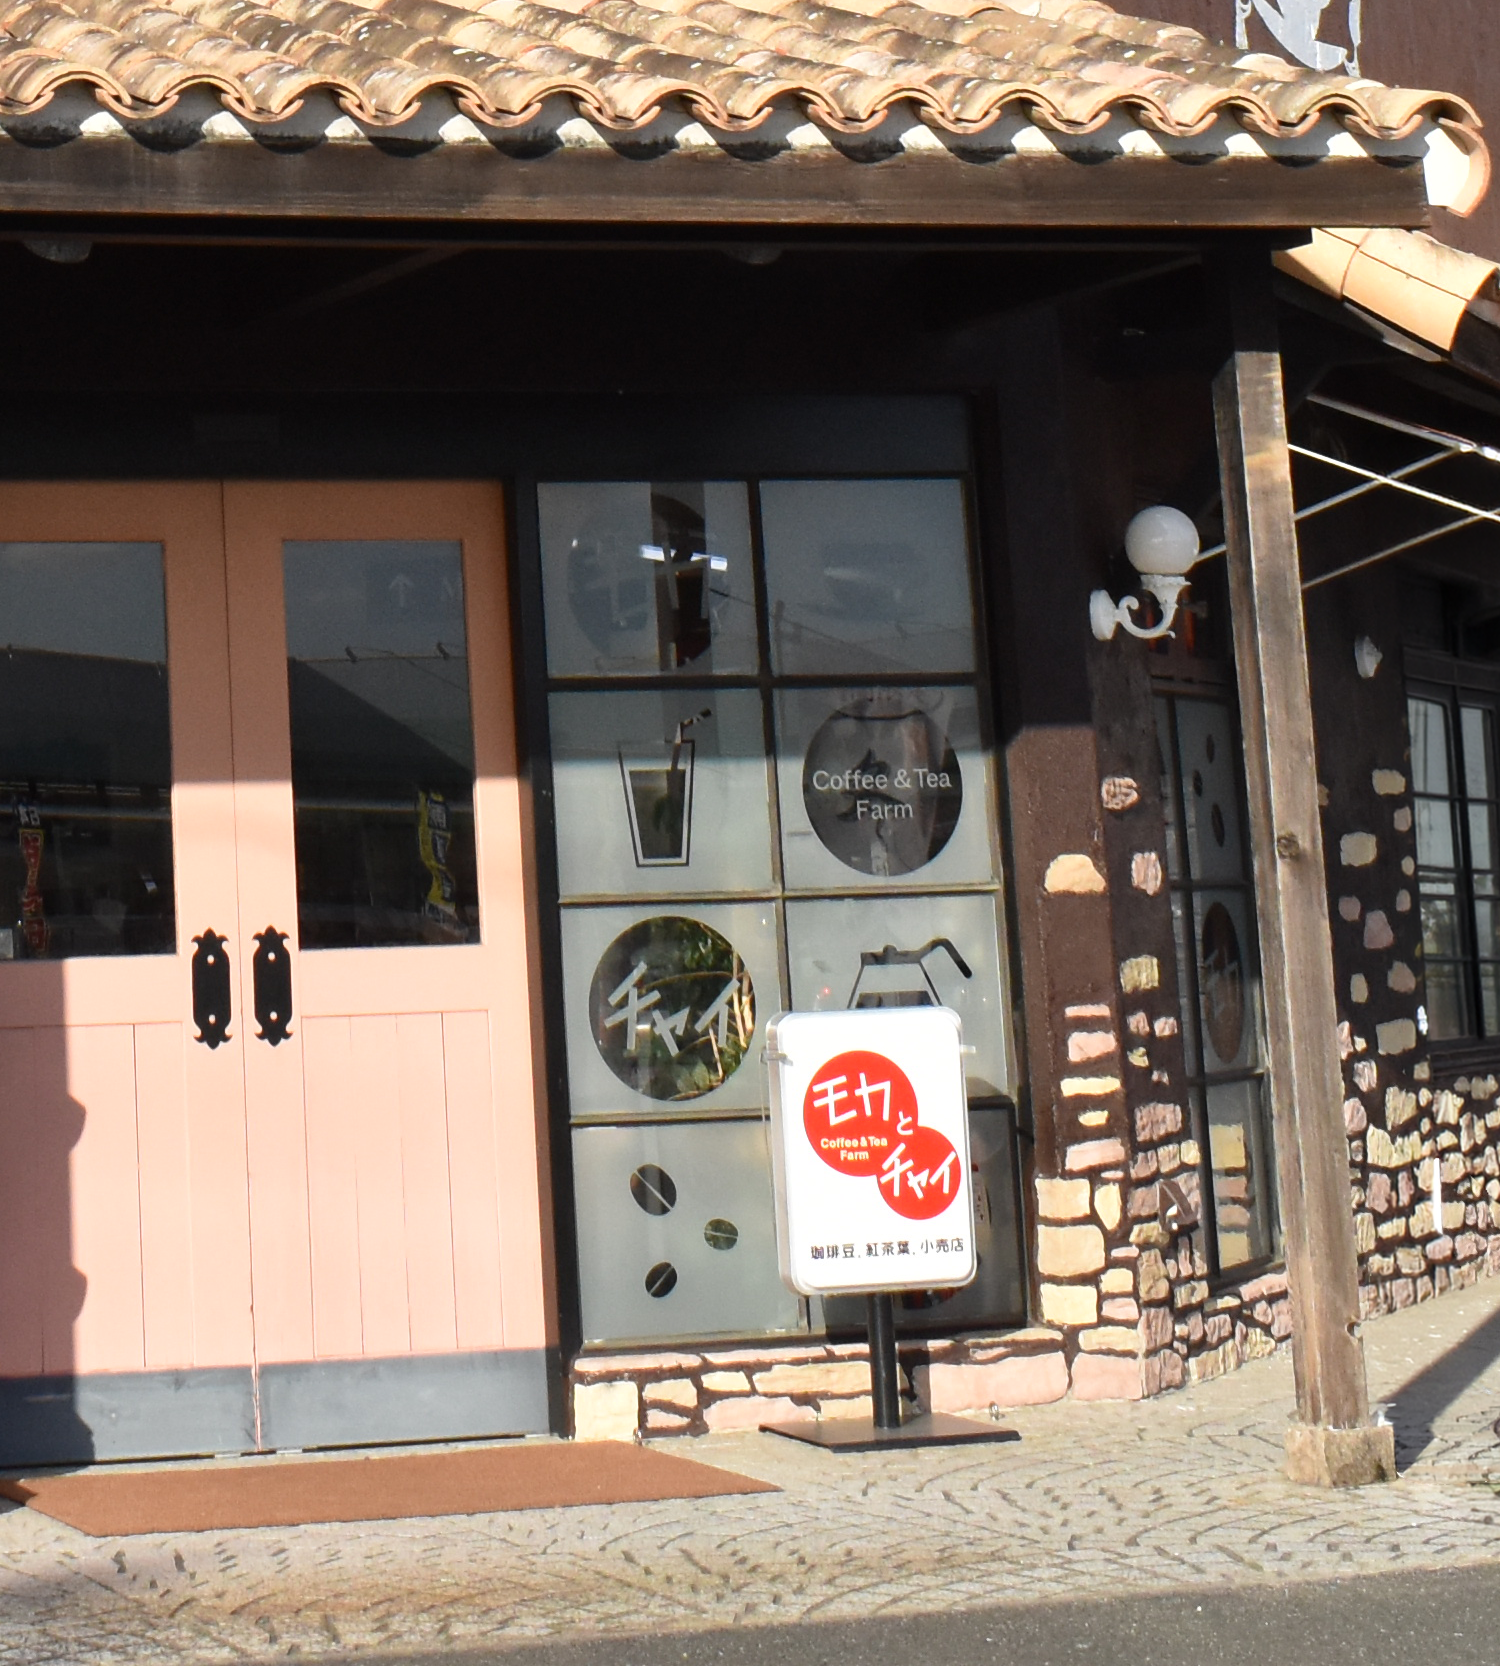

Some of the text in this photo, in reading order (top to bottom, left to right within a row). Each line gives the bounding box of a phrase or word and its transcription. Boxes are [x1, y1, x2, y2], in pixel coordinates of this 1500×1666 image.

[812, 768, 953, 790] Coffee & Tea
[856, 800, 914, 820] Farm
[604, 960, 740, 1057] チャイ
[812, 1072, 914, 1135] モカと
[820, 1136, 888, 1149] Coffee & Tea
[840, 1150, 869, 1161] Farm
[880, 1143, 956, 1199] チャイ
